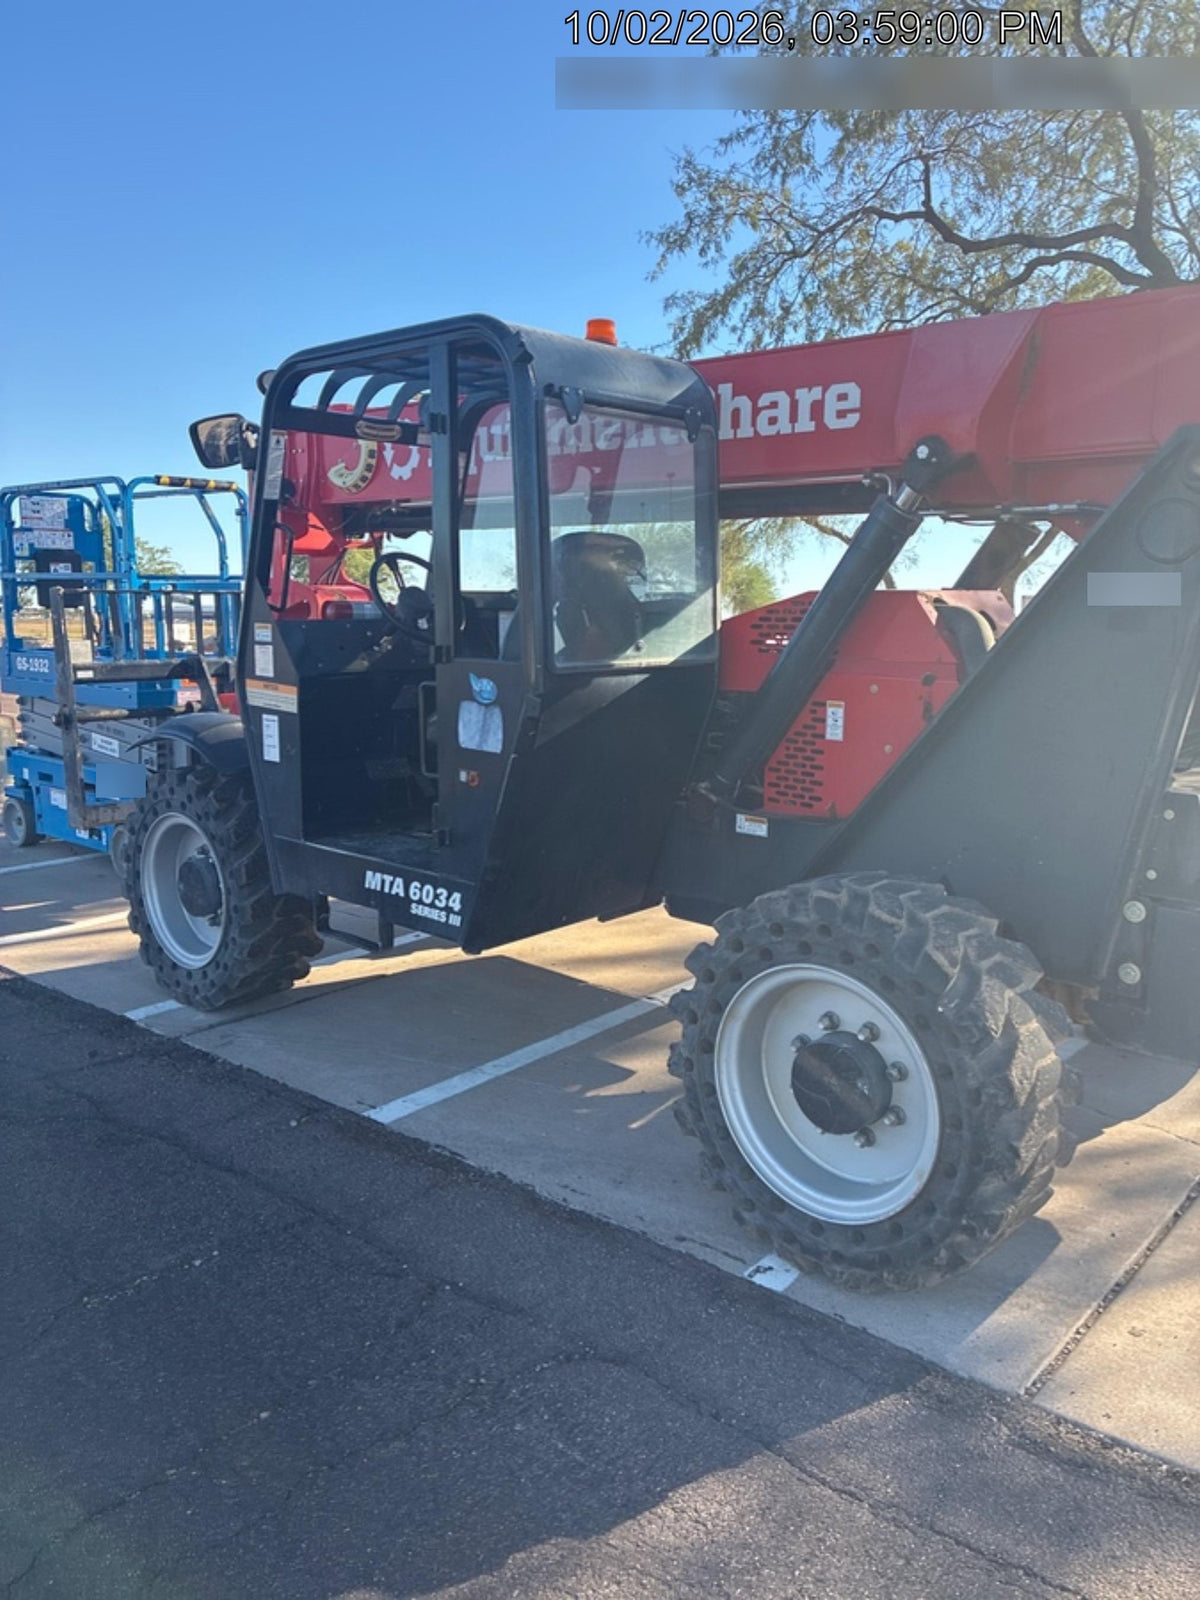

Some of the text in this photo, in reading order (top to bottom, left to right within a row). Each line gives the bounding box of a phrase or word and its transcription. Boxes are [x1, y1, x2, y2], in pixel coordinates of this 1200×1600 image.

[364, 870, 462, 912] MTA 6034
[410, 902, 447, 923] SERIES
